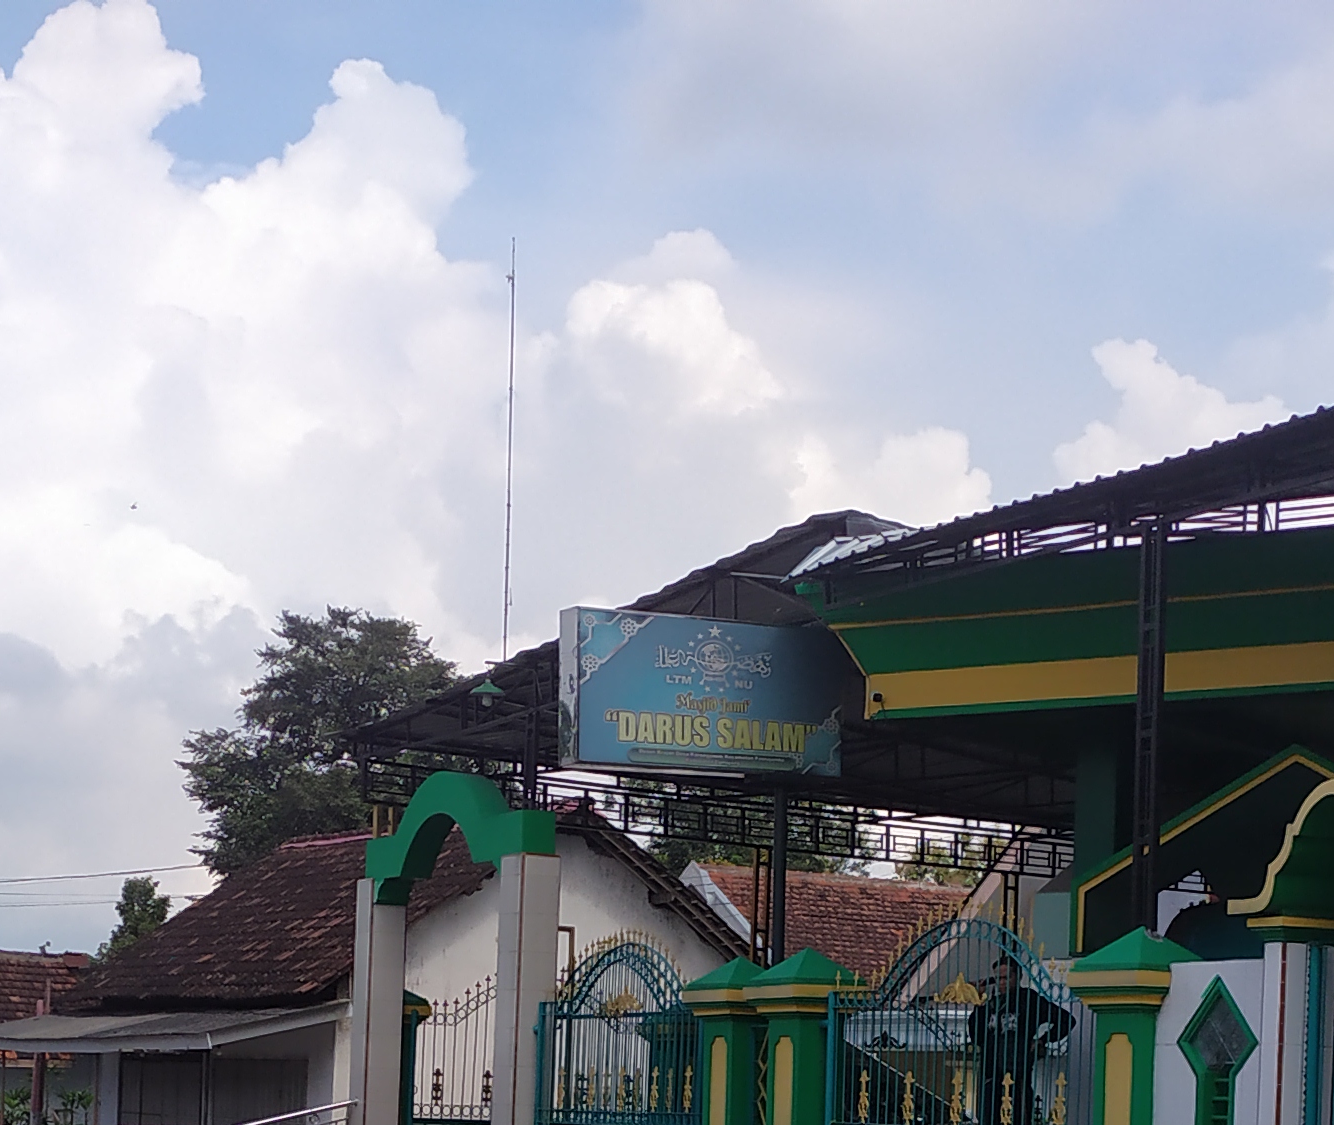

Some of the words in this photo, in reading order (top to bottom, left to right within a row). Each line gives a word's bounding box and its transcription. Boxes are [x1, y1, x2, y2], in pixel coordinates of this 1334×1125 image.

[665, 675, 692, 685] LTM
[734, 680, 753, 690] NU
[675, 691, 718, 714] Masjid
